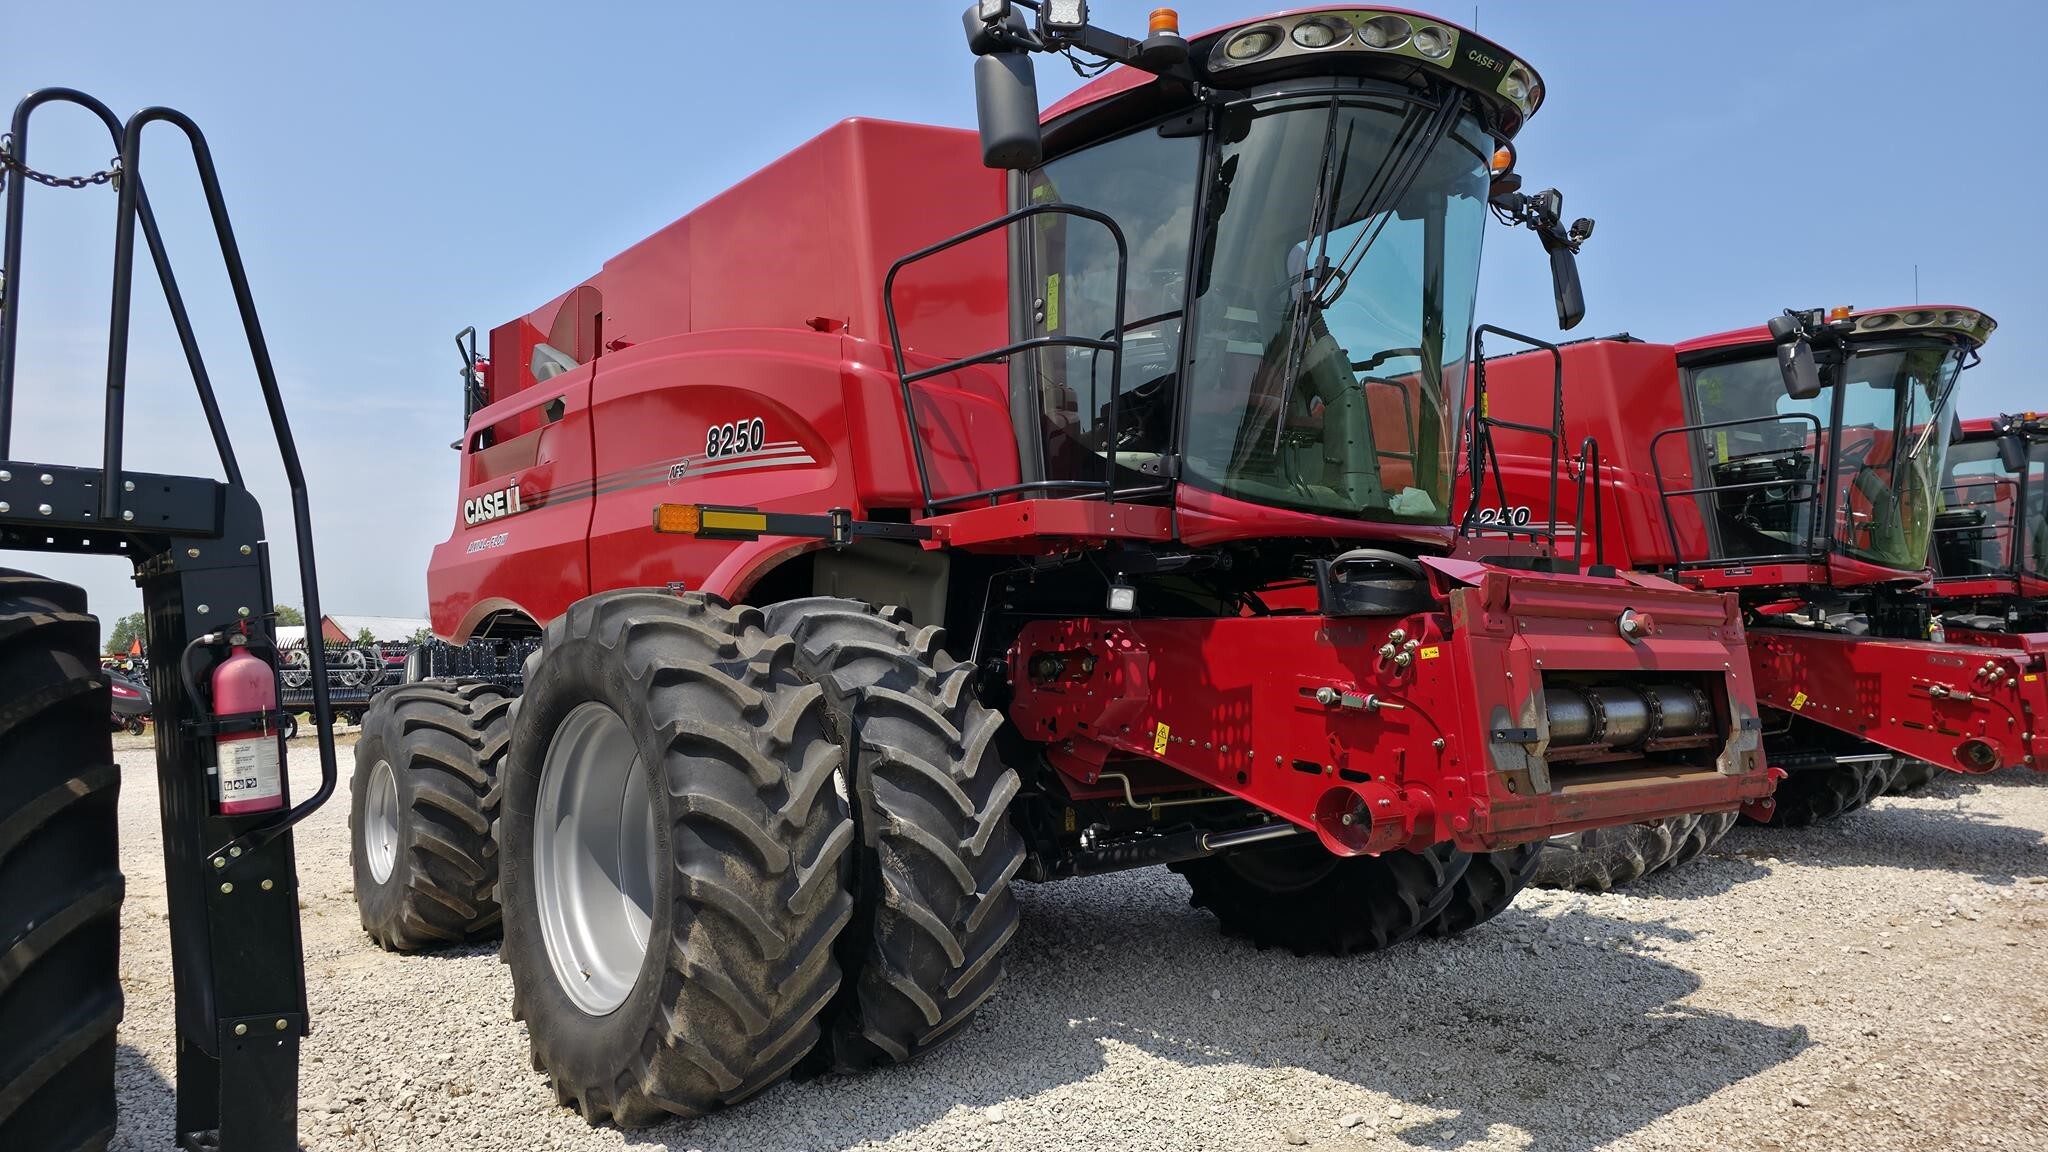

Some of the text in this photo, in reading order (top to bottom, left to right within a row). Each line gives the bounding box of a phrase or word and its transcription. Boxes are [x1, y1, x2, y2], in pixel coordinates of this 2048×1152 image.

[1468, 49, 1495, 69] CASE
[705, 416, 766, 460] 8250
[668, 464, 685, 480] AFS
[464, 489, 506, 525] CASE
[1463, 506, 1531, 527] 250
